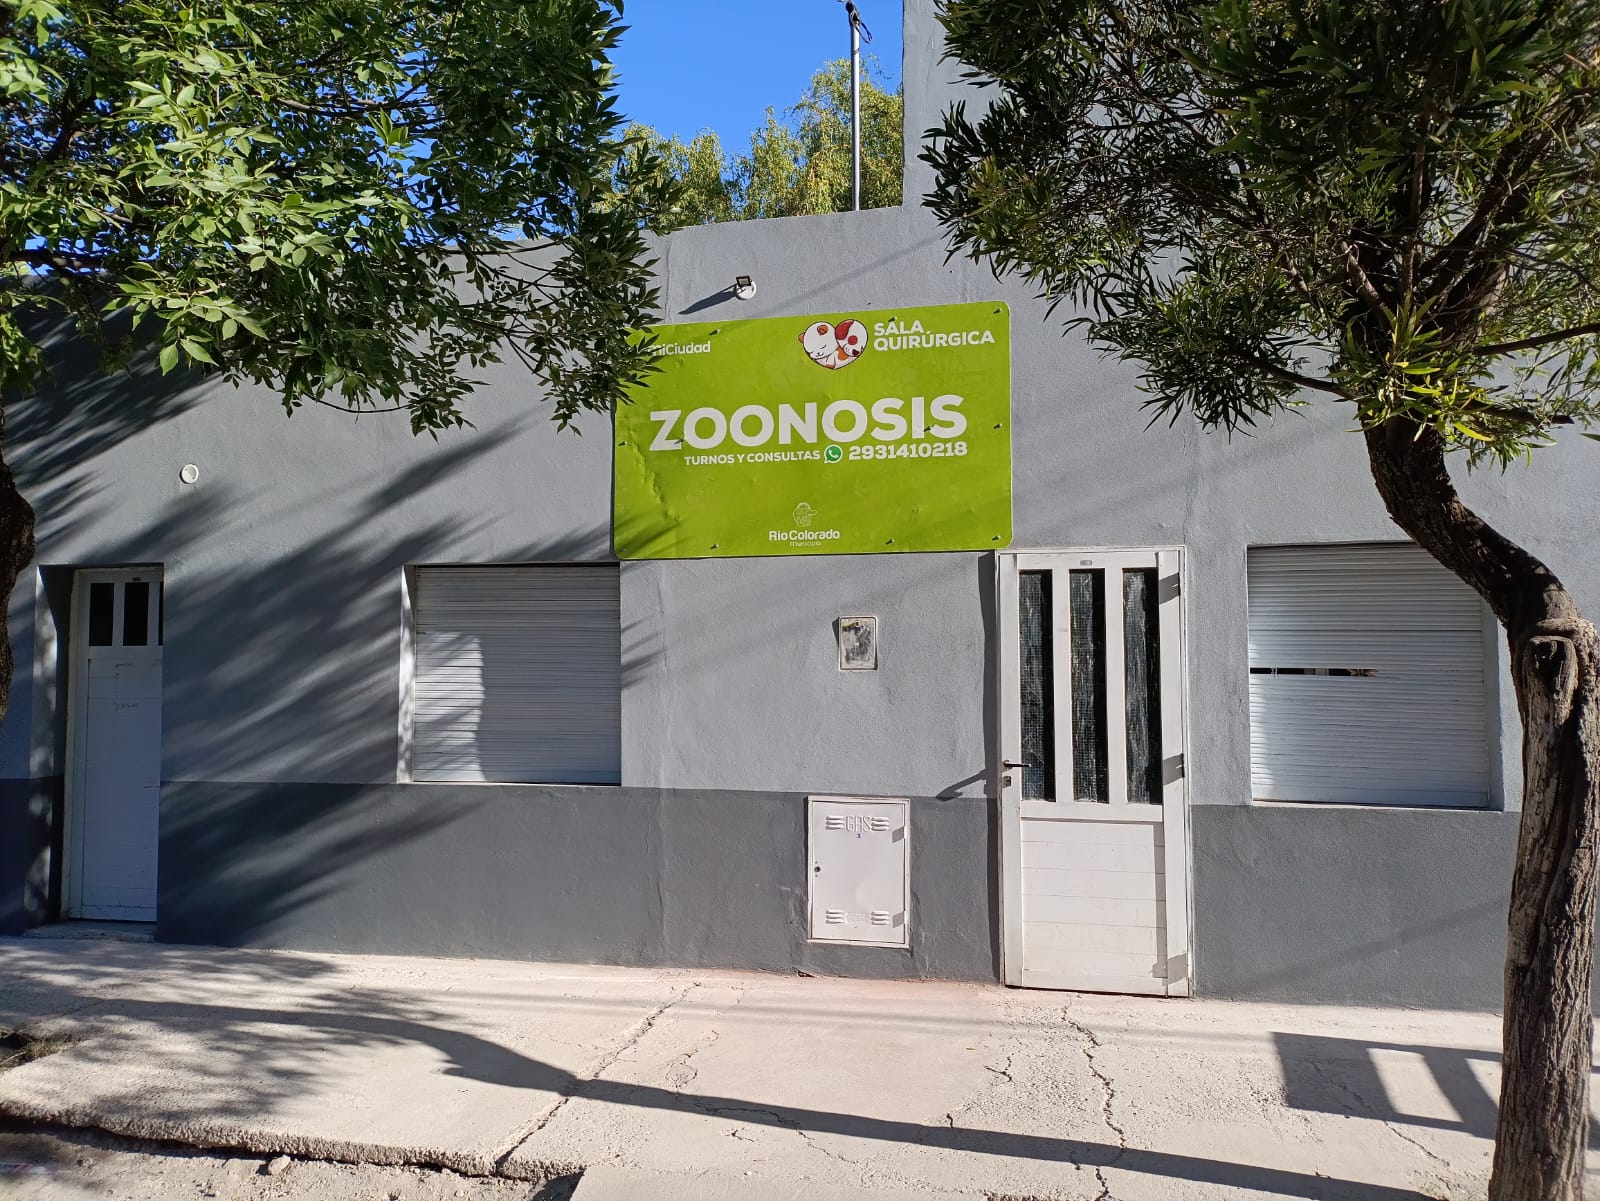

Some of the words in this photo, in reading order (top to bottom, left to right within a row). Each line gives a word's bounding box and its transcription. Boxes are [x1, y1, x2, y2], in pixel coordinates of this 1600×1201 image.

[873, 320, 924, 336] SALA
[873, 330, 995, 351] QUIRÚRGICA
[649, 394, 968, 451] ZOONOSIS
[684, 454, 735, 465] TURNOS
[737, 453, 746, 463] Y
[747, 450, 820, 463] CONSULTAS
[848, 441, 968, 460] 2931410218
[845, 815, 872, 832] GAS
